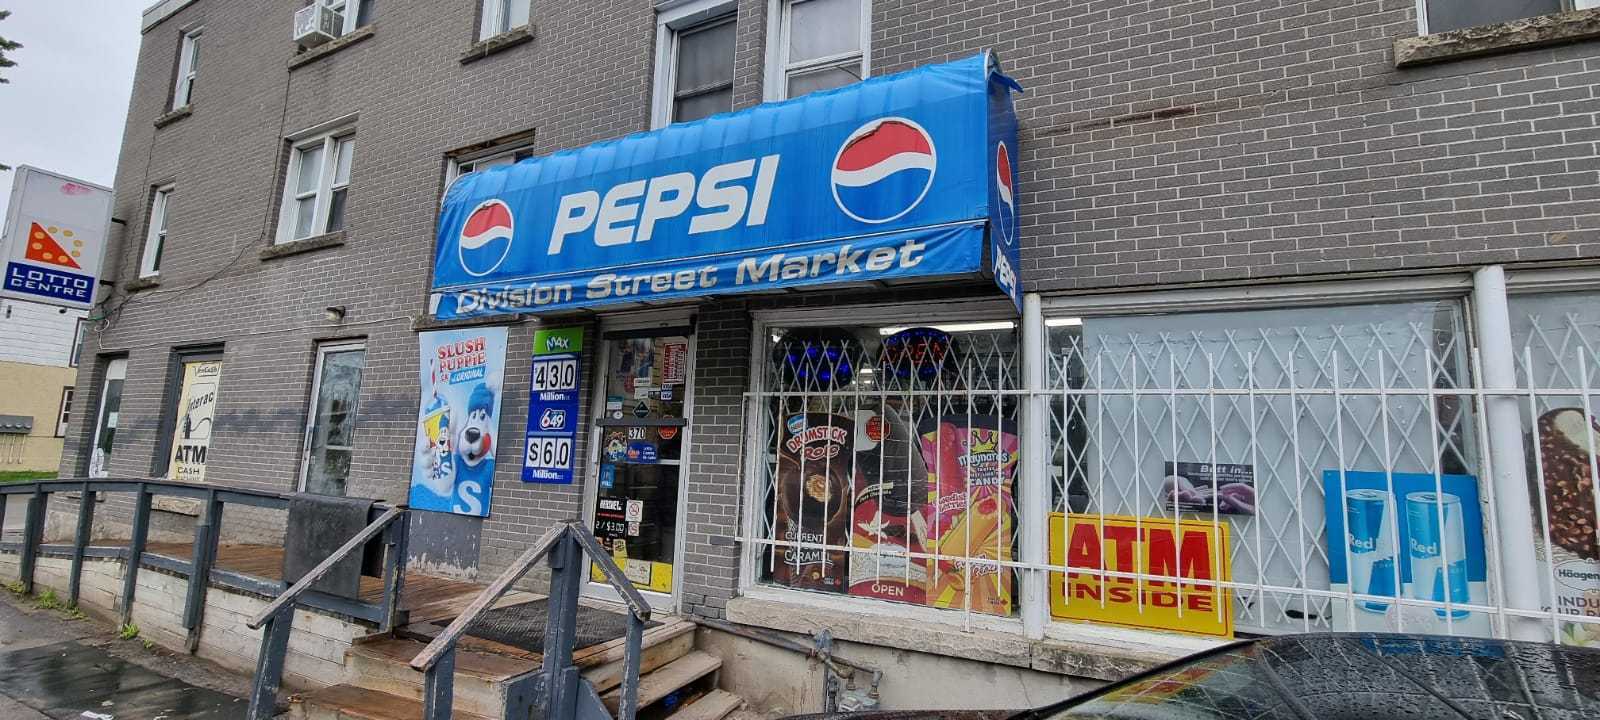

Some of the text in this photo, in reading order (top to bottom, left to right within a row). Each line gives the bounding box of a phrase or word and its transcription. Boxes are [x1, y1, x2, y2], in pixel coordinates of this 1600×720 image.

[547, 154, 780, 255] PEPSI
[12, 267, 88, 289] LOTTO
[456, 240, 926, 315] Division Street Market
[11, 278, 87, 297] CENTRE
[438, 337, 485, 359] SLUSH
[540, 392, 564, 401] Million
[786, 426, 848, 453] DRUMSTCK
[175, 445, 207, 464] ATM
[177, 466, 200, 474] CASH
[532, 469, 558, 480] Million
[1349, 532, 1374, 549] Red
[1410, 535, 1438, 555] Red
[785, 550, 830, 561] CARAML
[1063, 523, 1213, 592] ATM
[871, 583, 904, 597] OPEN
[1062, 582, 1214, 613] INSIDE
